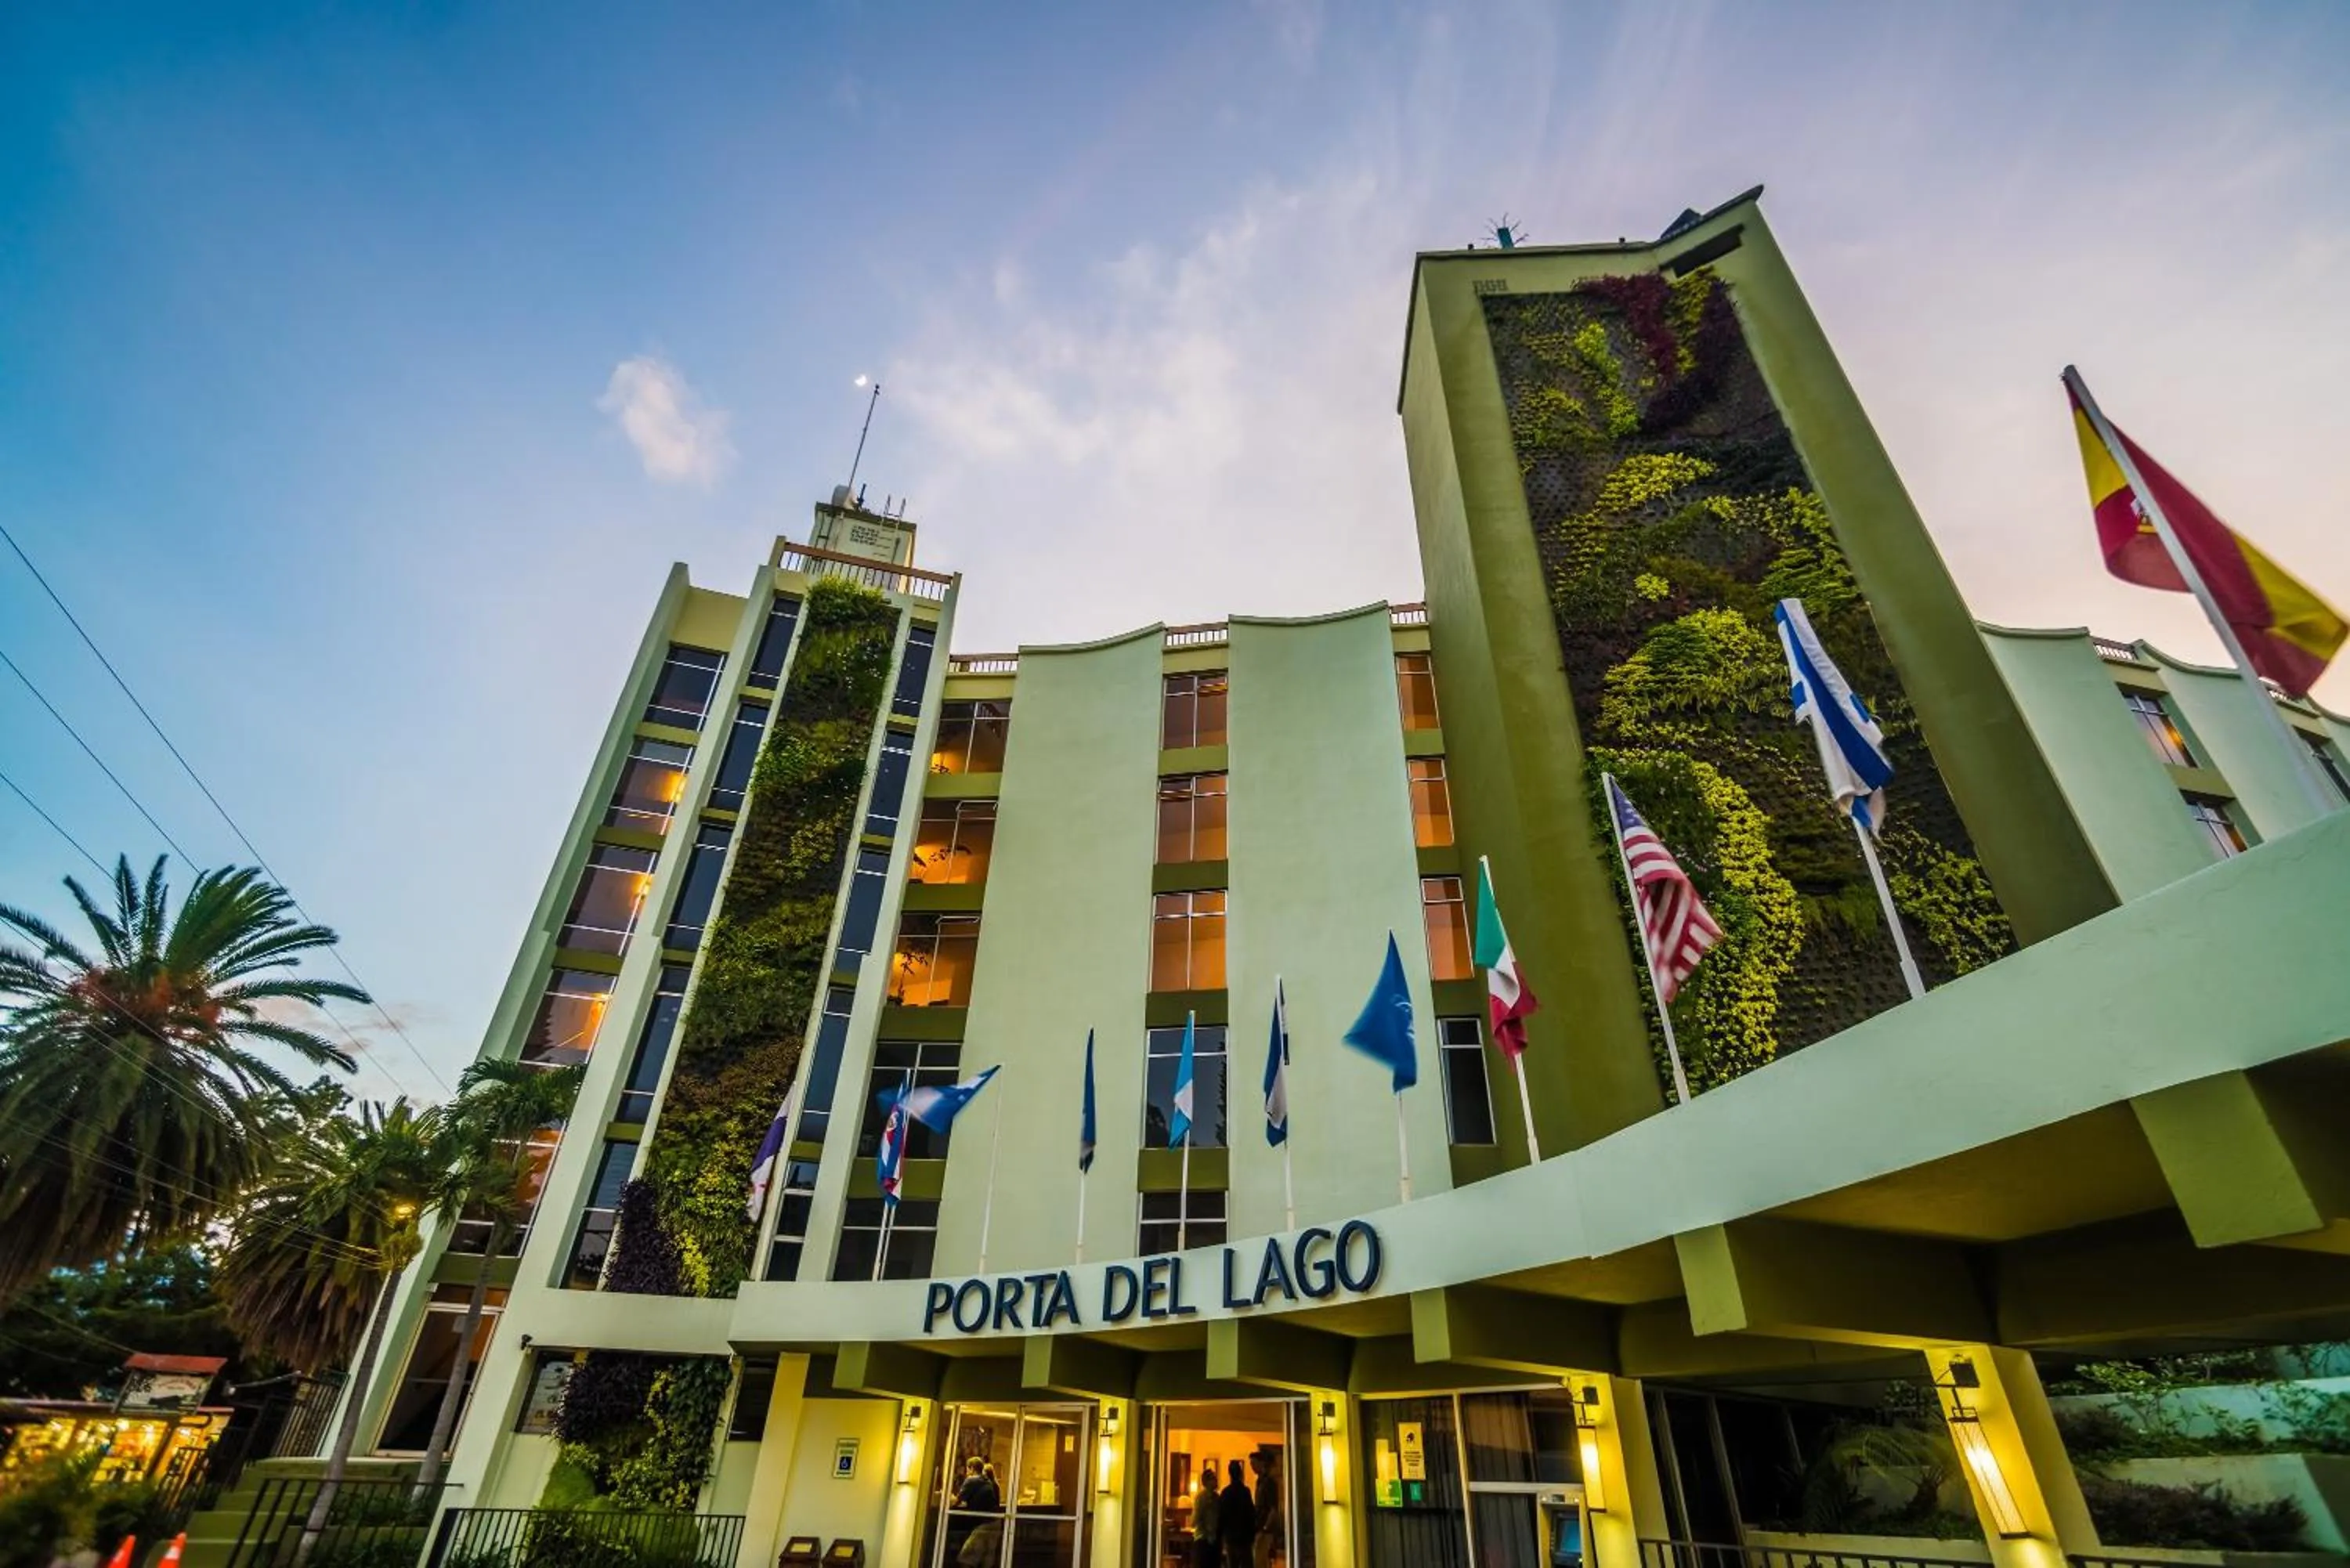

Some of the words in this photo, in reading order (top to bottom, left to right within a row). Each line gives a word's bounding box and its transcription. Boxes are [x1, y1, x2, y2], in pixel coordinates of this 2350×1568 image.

[923, 1270, 1081, 1333] PORTA
[1102, 1257, 1197, 1322] DEL
[1223, 1220, 1381, 1309] LAGO
